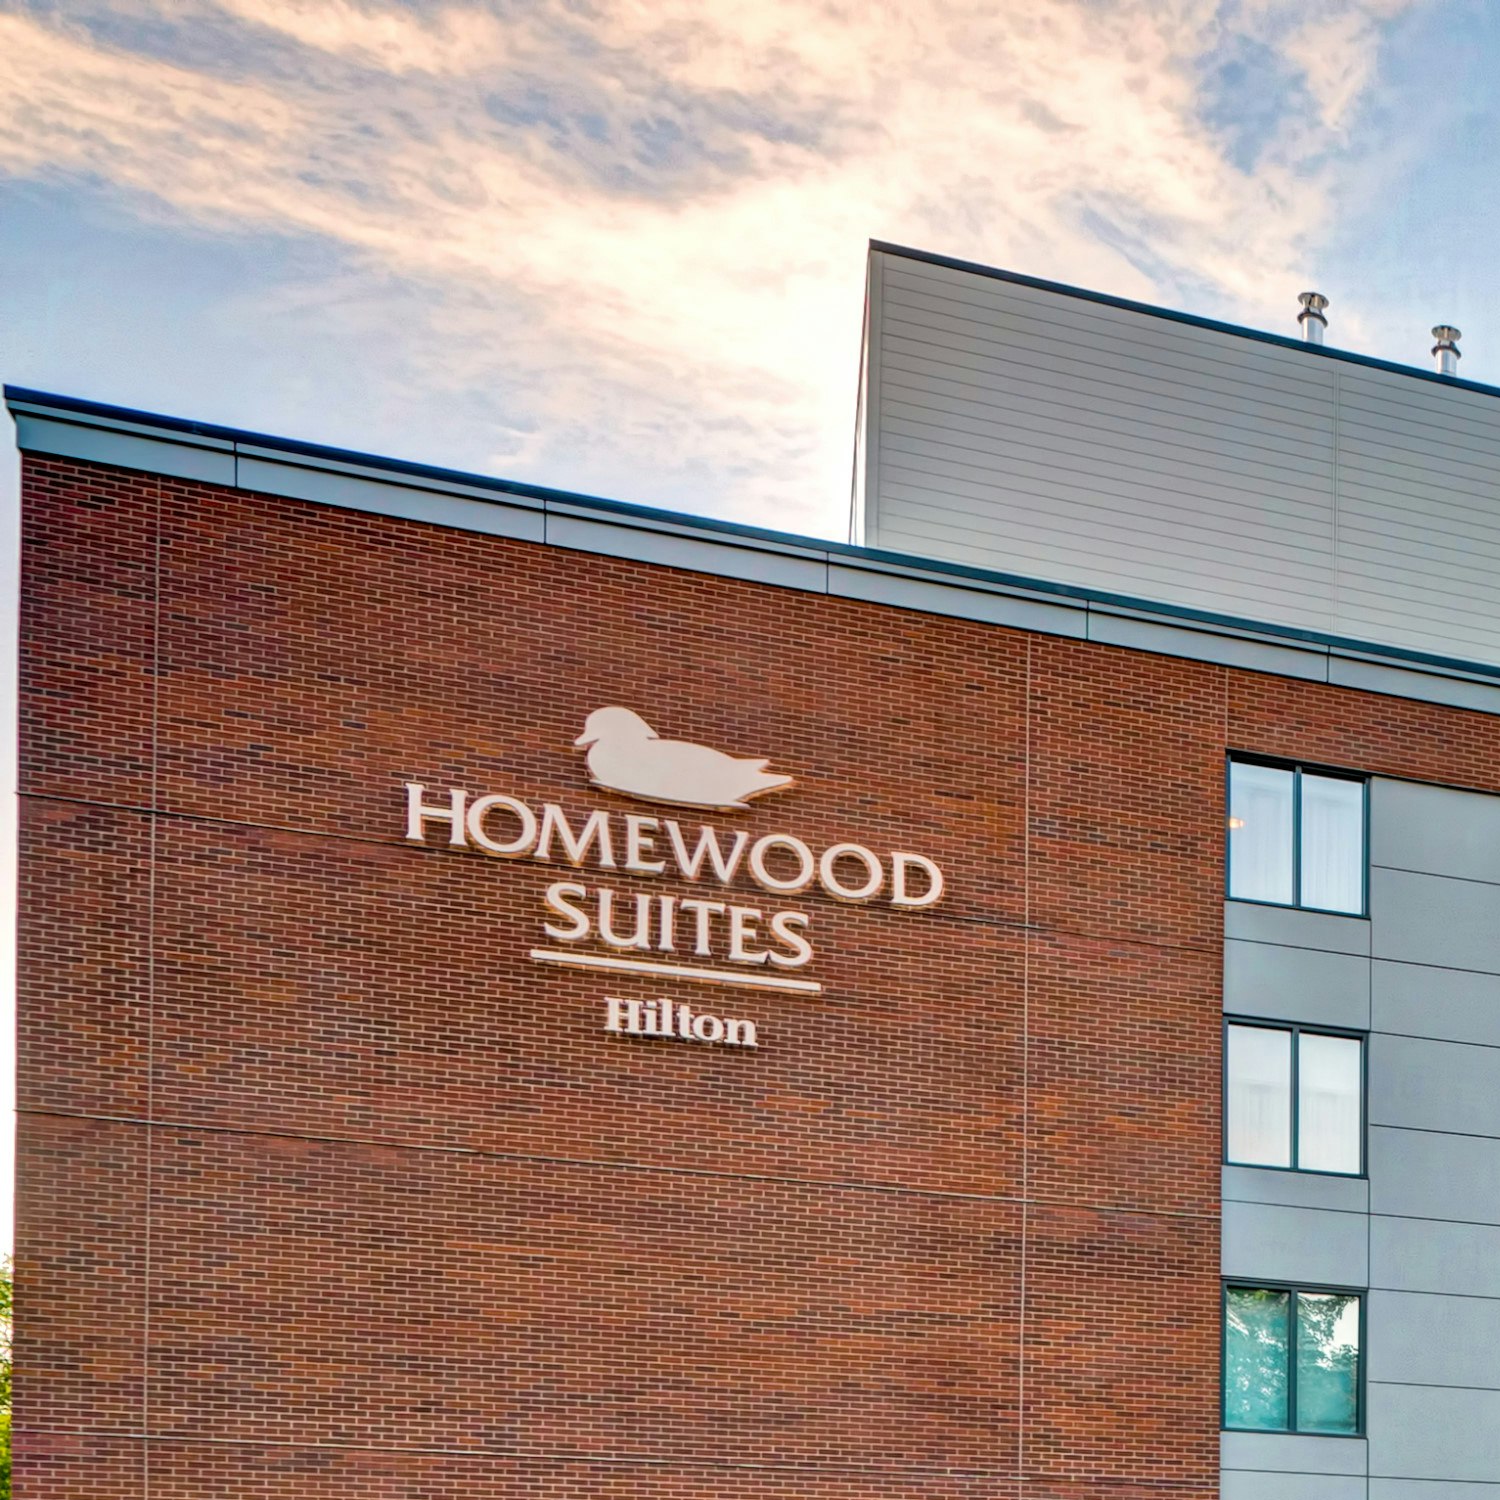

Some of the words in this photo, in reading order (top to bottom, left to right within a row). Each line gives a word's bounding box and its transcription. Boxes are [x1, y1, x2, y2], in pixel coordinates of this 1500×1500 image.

[404, 782, 944, 907] HOMEWOOD
[543, 881, 814, 968] SUITES
[604, 996, 758, 1047] Hilton
